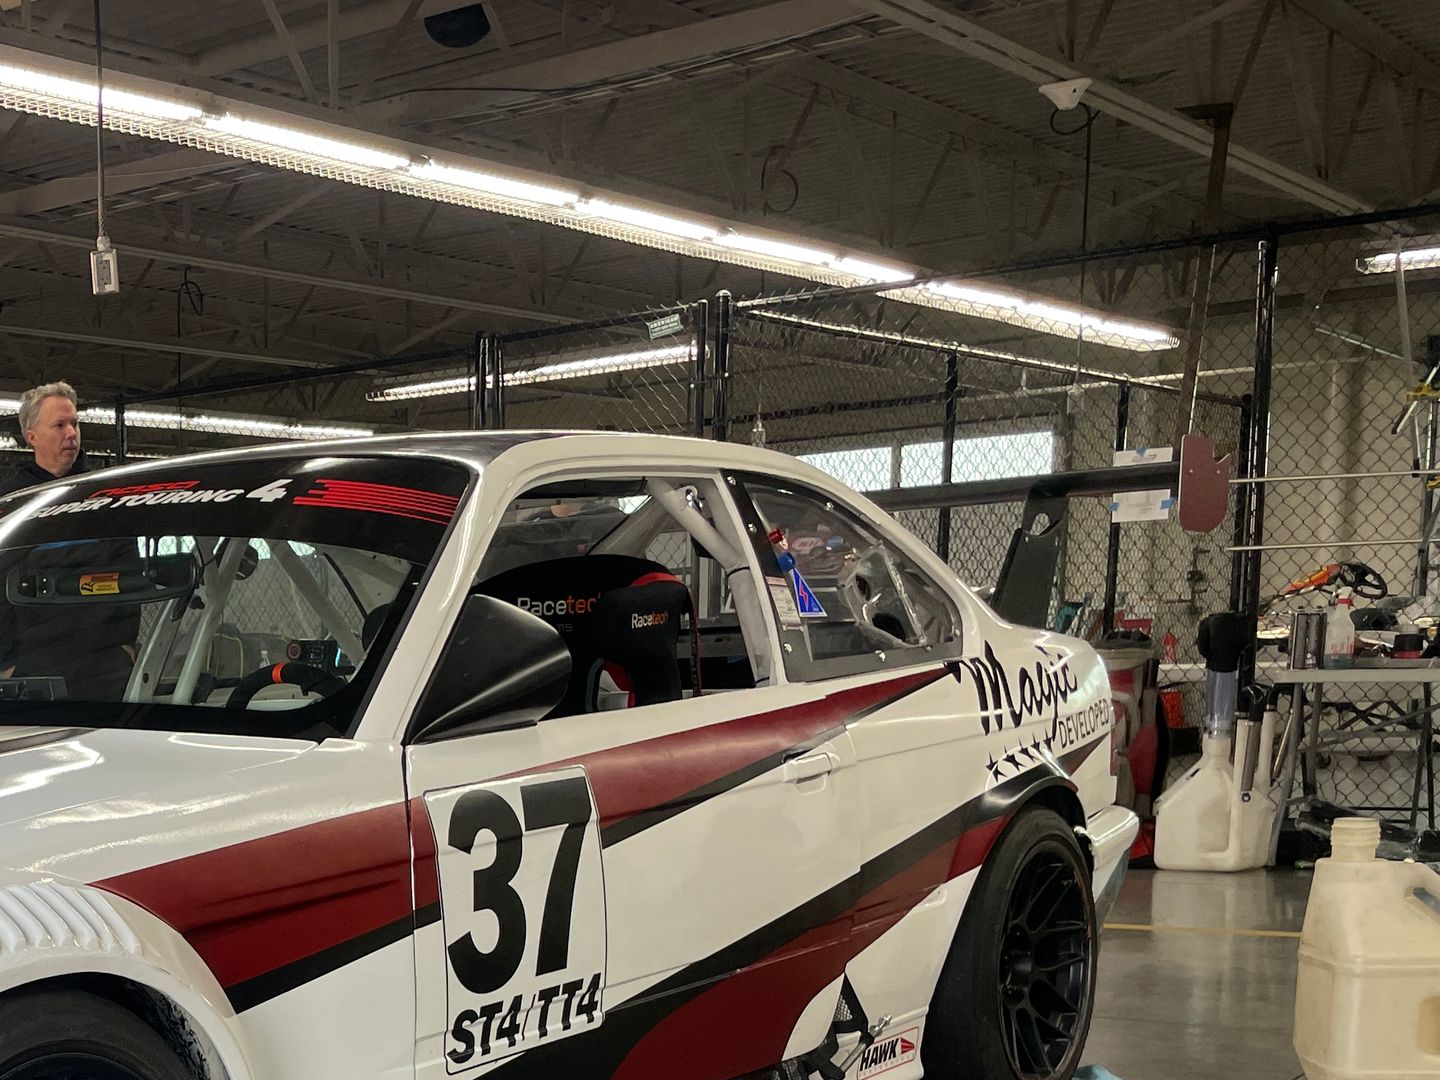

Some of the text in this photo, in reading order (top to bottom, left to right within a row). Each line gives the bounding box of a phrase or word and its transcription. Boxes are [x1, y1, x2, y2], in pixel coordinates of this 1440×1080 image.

[24, 479, 293, 520] SUPER TOURING 4
[517, 592, 601, 617] Racetec
[631, 612, 669, 629] Racetech
[959, 639, 1078, 742] Magic
[1058, 700, 1110, 749] DEVELOPED
[447, 776, 592, 994] 37
[446, 972, 602, 1065] ST4/TT4
[860, 1037, 900, 1072] HAWK
